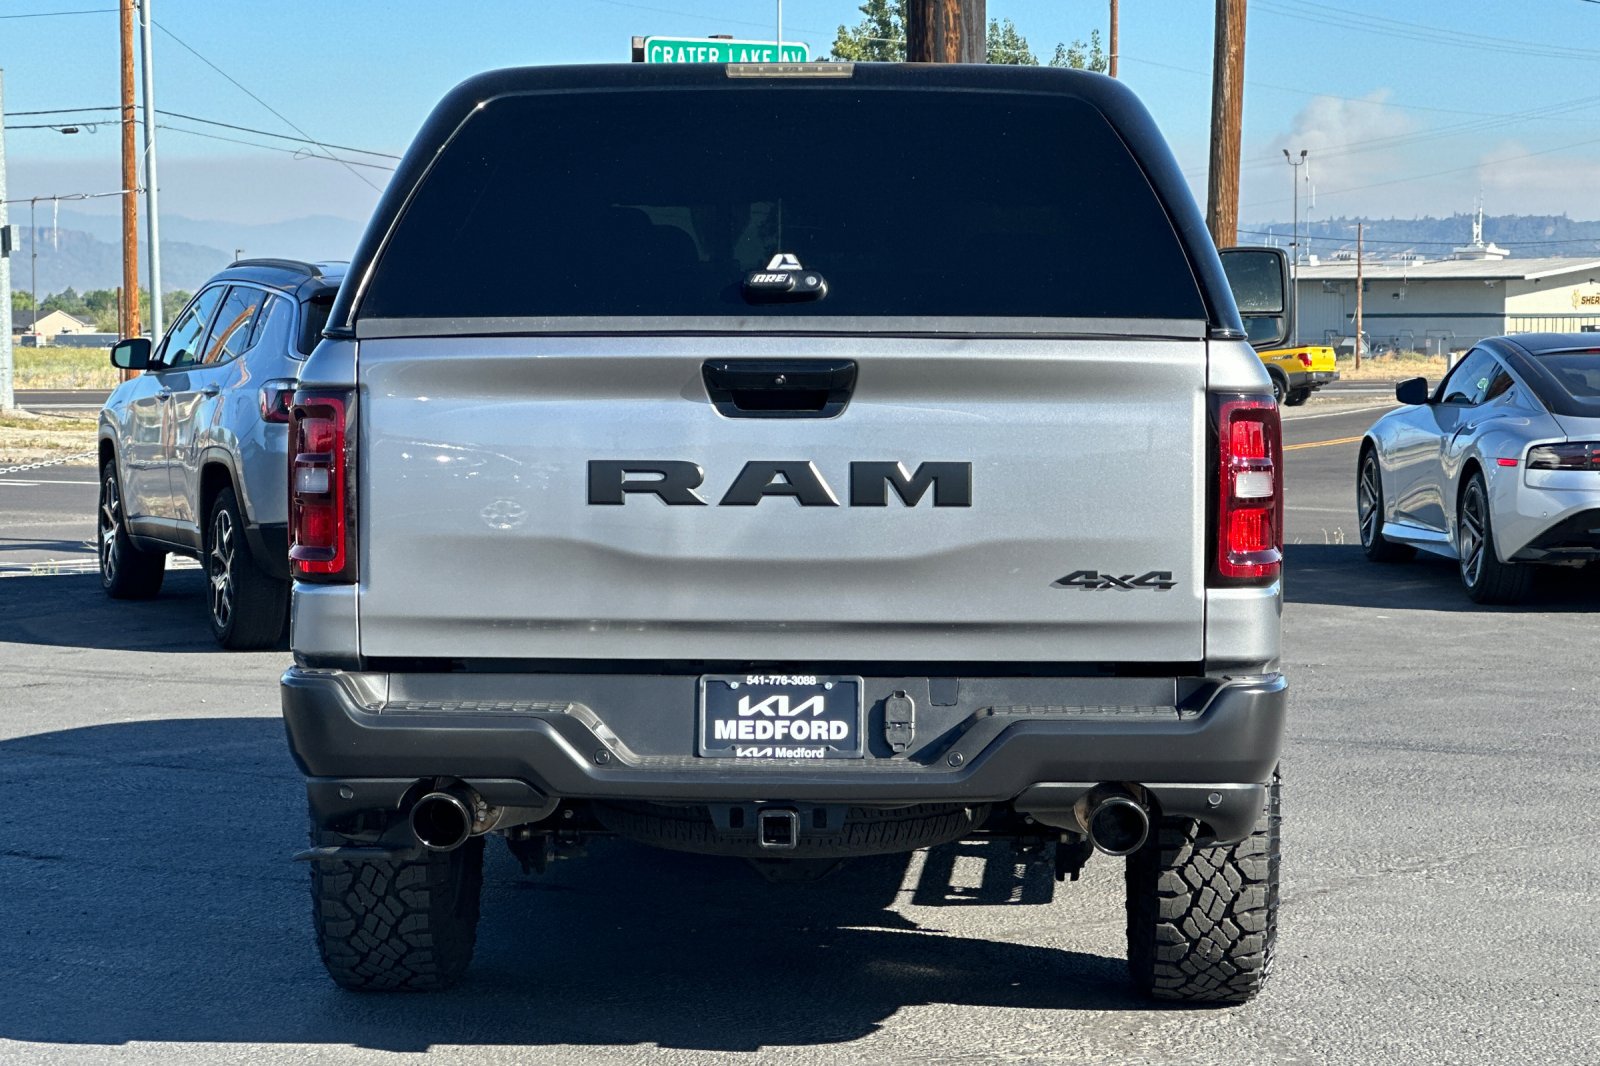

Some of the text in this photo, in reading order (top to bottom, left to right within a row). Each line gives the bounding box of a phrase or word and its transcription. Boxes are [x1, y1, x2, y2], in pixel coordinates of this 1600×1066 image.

[586, 459, 973, 508] RAM
[746, 675, 817, 685] 541-776-3088
[738, 695, 825, 717] KIA
[714, 719, 849, 741] MEDFORD
[775, 746, 825, 759] Medford
